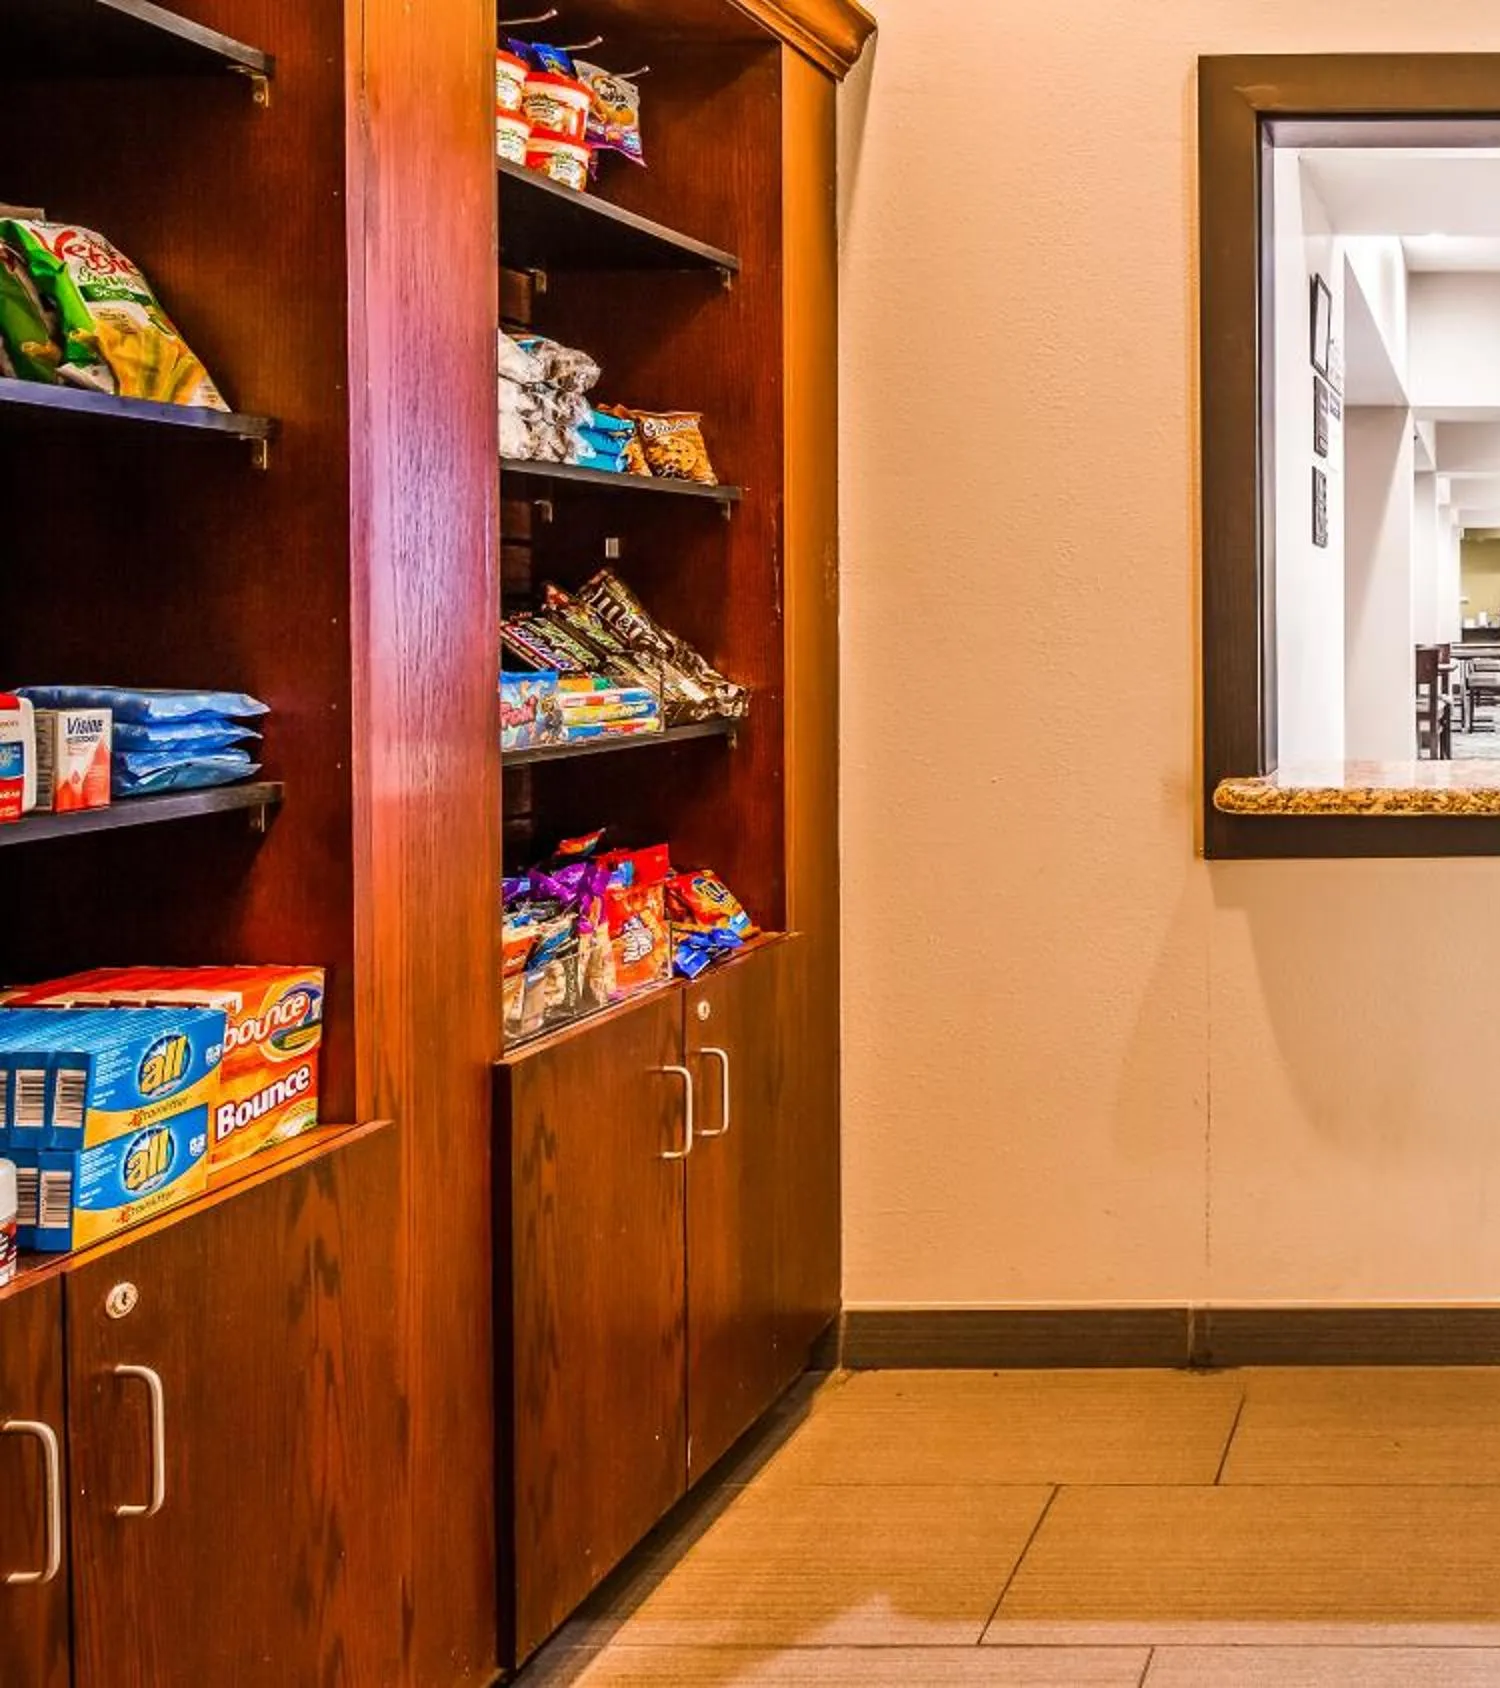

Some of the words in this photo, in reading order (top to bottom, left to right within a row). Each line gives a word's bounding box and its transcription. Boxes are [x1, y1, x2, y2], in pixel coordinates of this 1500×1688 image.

[67, 716, 104, 735] Visine
[140, 1034, 187, 1094] all
[215, 1064, 311, 1142] Bounce
[125, 1127, 170, 1191] all
